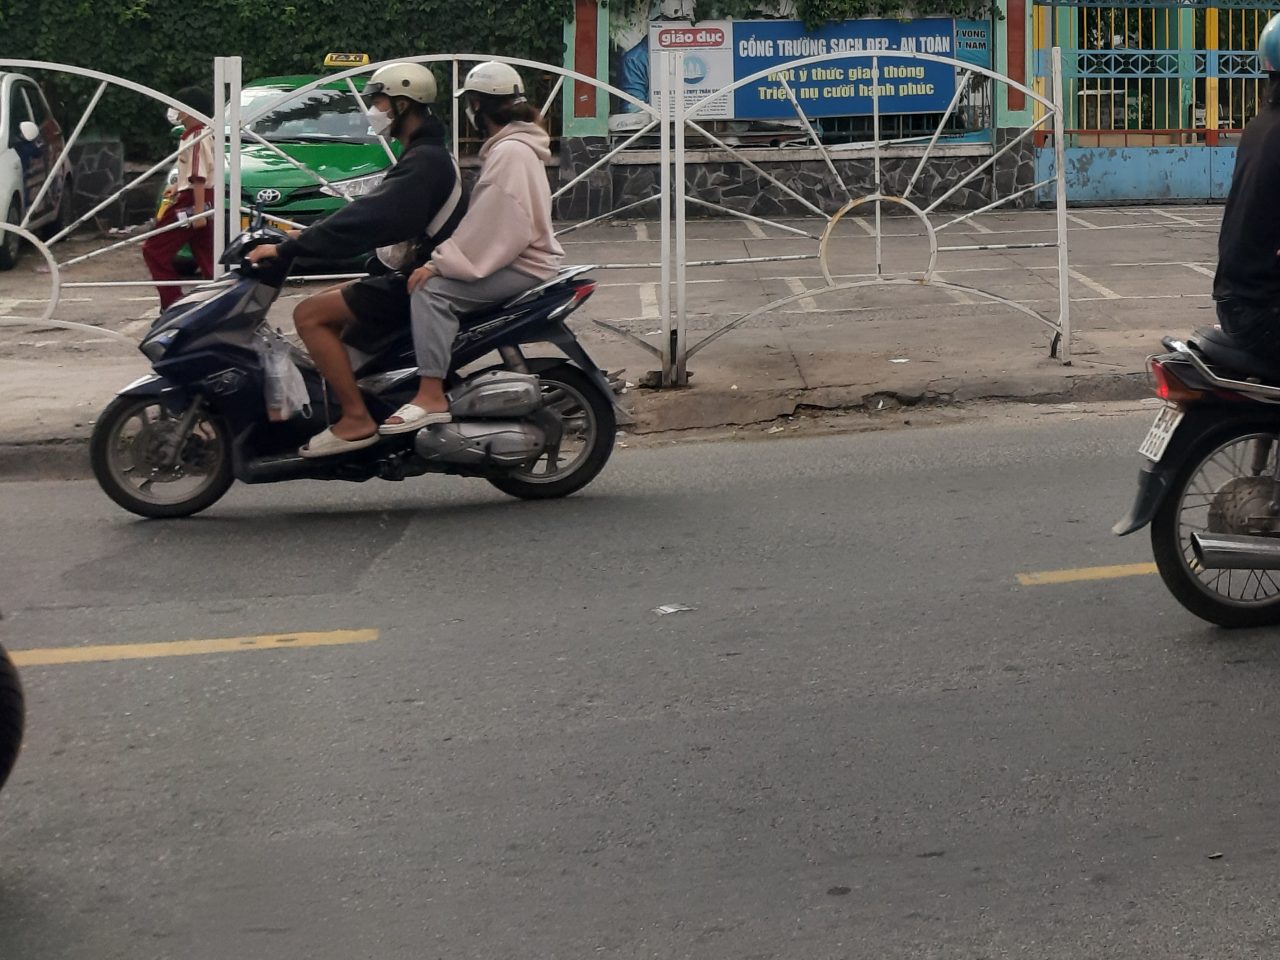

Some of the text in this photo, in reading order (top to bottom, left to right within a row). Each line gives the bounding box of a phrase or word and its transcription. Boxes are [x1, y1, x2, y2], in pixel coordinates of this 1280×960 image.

[661, 30, 723, 45] giáo dục
[961, 29, 986, 38] VONG
[739, 34, 773, 58] CỔNG
[777, 36, 827, 57] TRƯỜNG
[900, 37, 916, 52] AN
[919, 33, 951, 53] TOÀN
[965, 41, 987, 50] NAM
[799, 68, 808, 82] ý
[811, 67, 844, 81] thức
[883, 65, 925, 79] thông
[800, 87, 819, 101] nụ
[823, 84, 855, 98] cười
[899, 81, 935, 97] phúc
